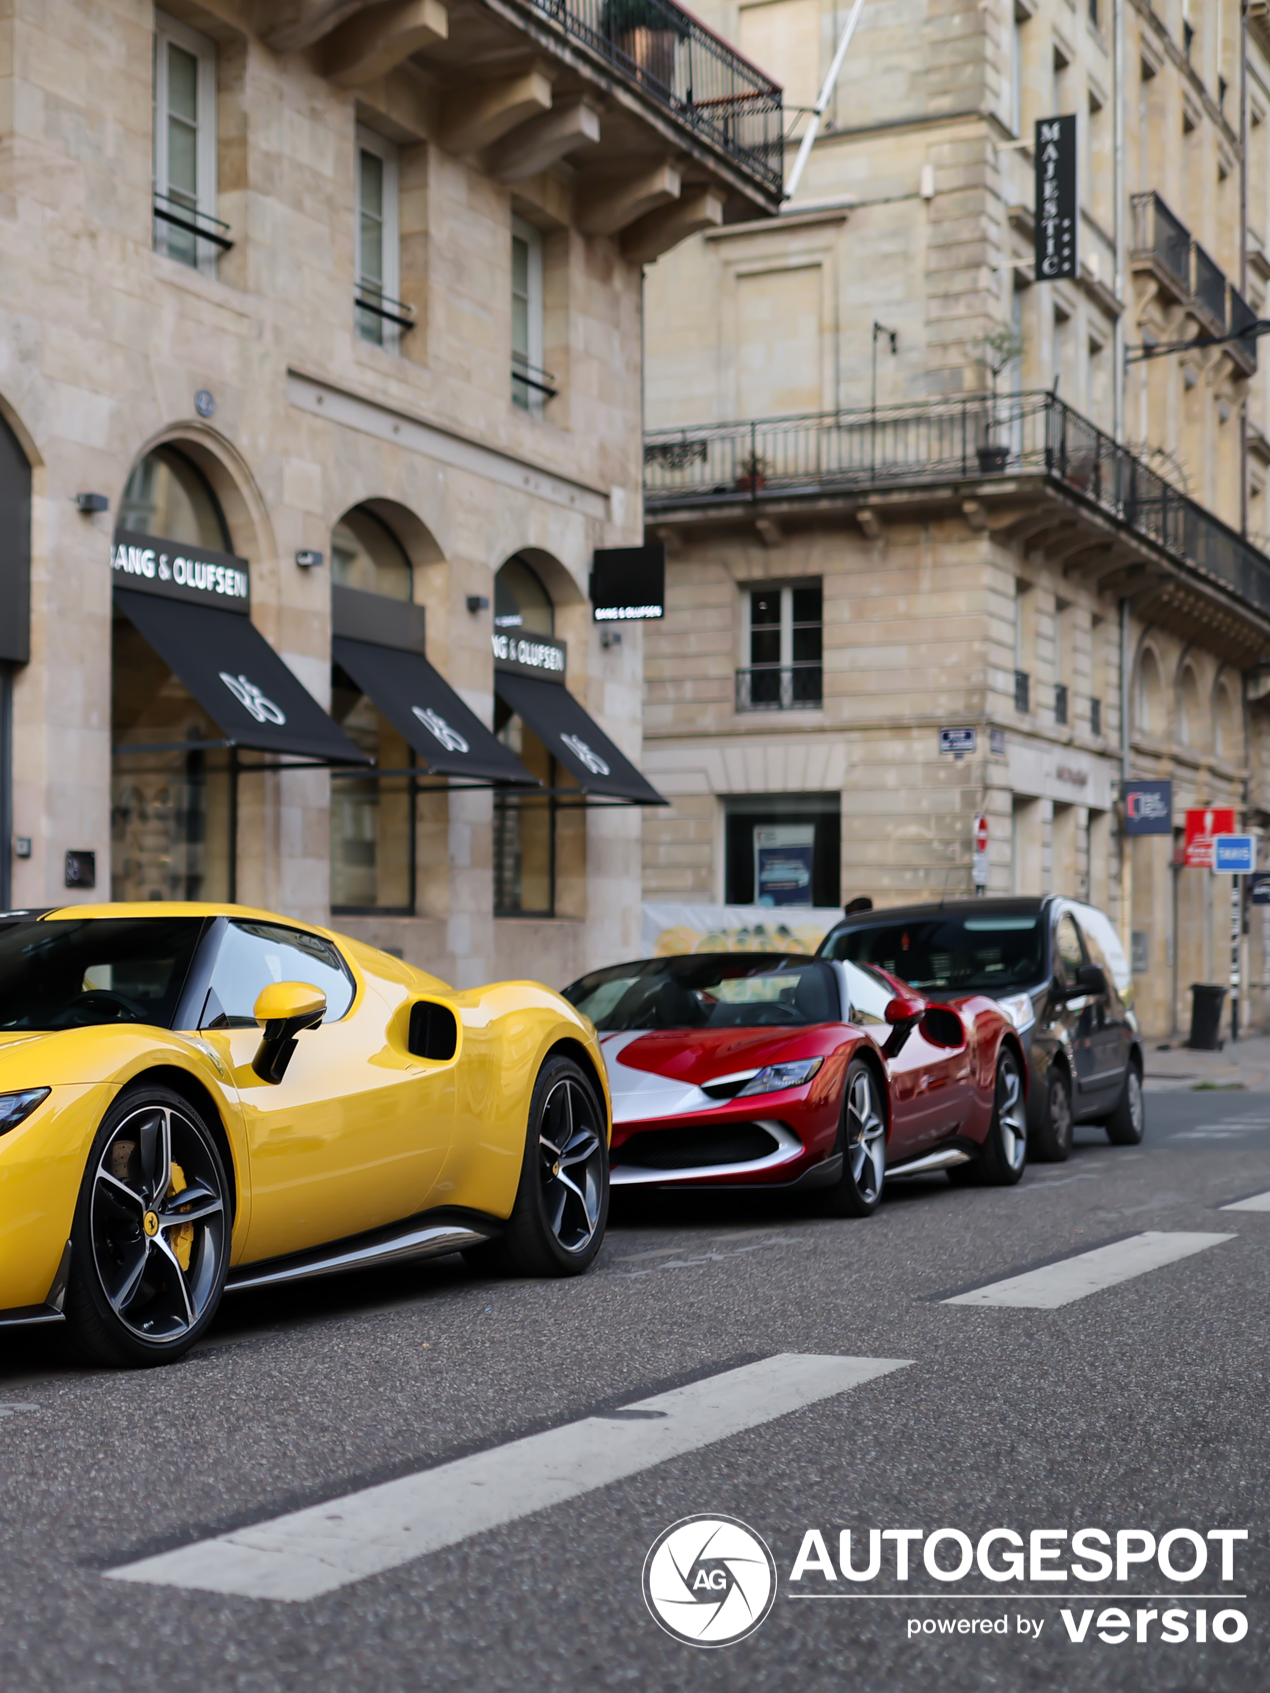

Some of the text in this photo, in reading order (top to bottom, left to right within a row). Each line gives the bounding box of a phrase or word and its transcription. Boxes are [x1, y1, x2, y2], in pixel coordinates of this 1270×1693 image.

[1040, 122, 1061, 276] MAJESTIC
[158, 553, 172, 581] &
[172, 556, 248, 598] OLUFSEN
[517, 639, 564, 672] OLUFSEN
